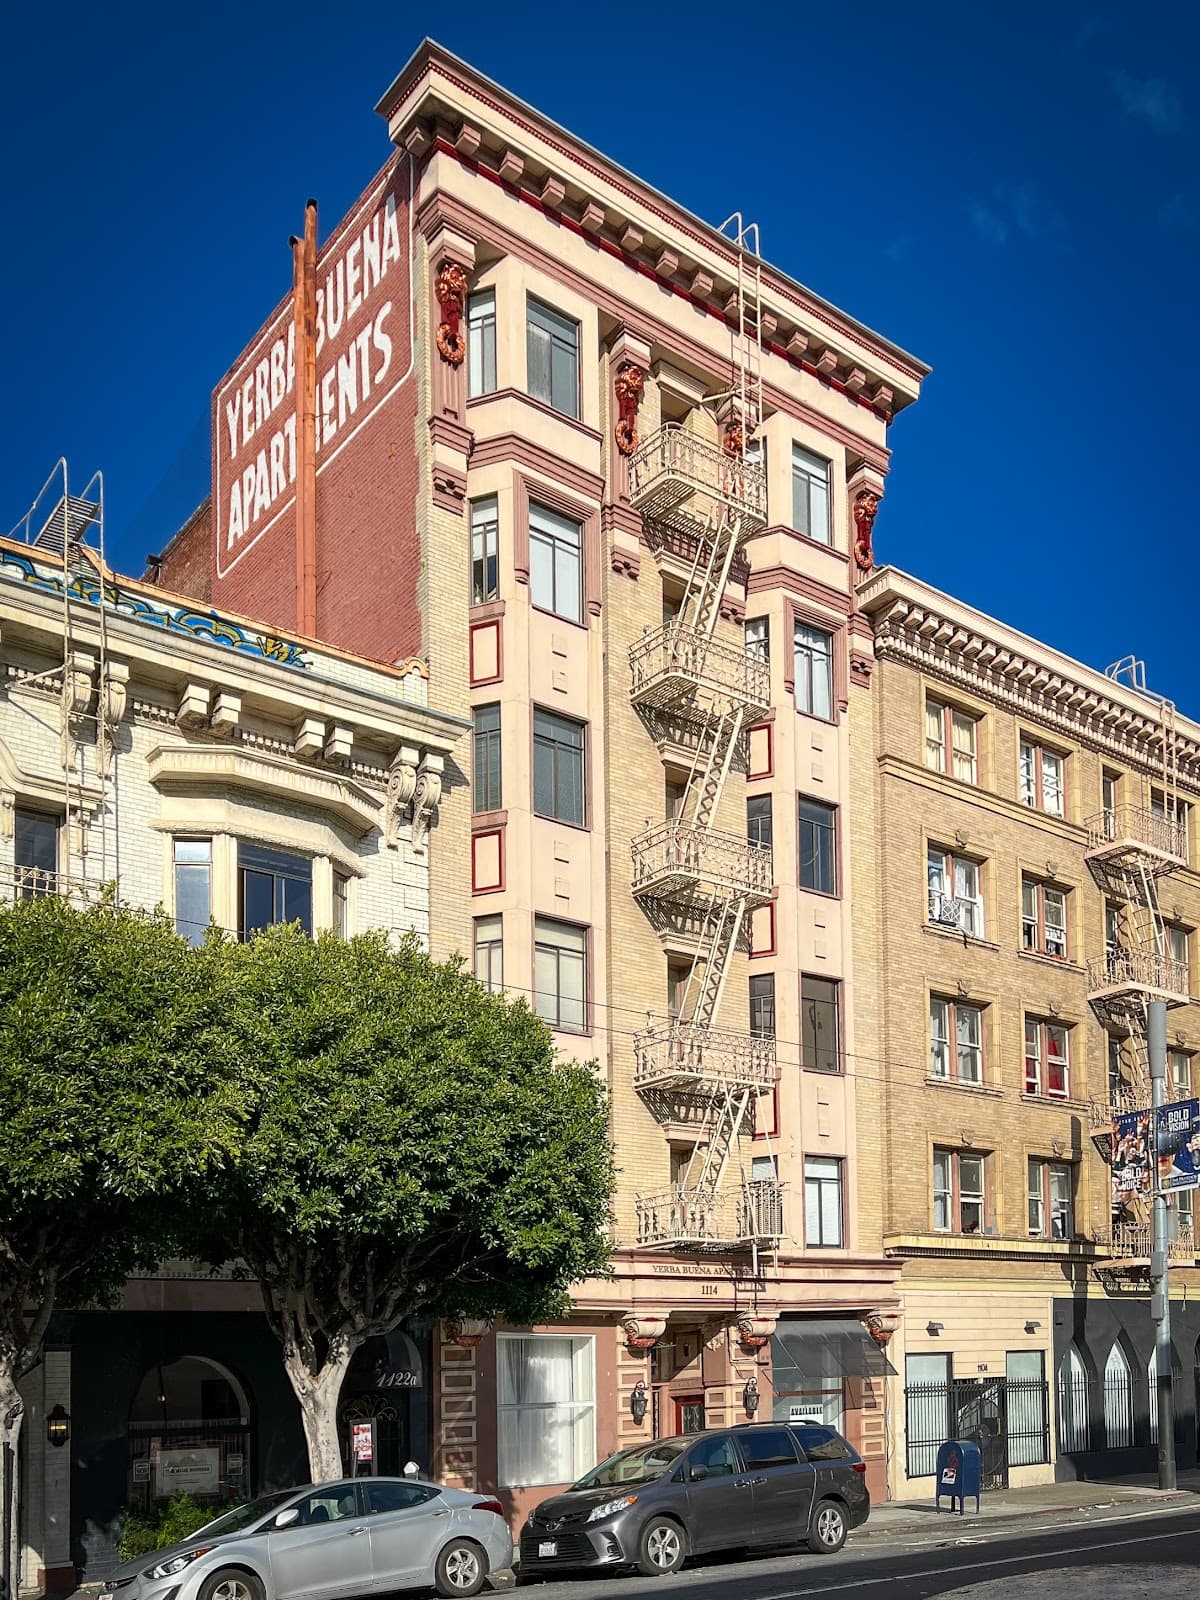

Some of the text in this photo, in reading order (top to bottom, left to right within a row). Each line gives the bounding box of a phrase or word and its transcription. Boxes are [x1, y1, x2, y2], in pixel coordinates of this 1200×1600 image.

[226, 320, 296, 459] YERBA
[227, 301, 392, 551] APARTENTS
[1168, 1108, 1189, 1123] BOLD
[1168, 1120, 1189, 1132] VISION
[652, 1265, 681, 1274] YERBA
[682, 1266, 712, 1275] BUENA
[701, 1285, 718, 1295] 1114
[790, 1406, 823, 1416] AVAILABLE
